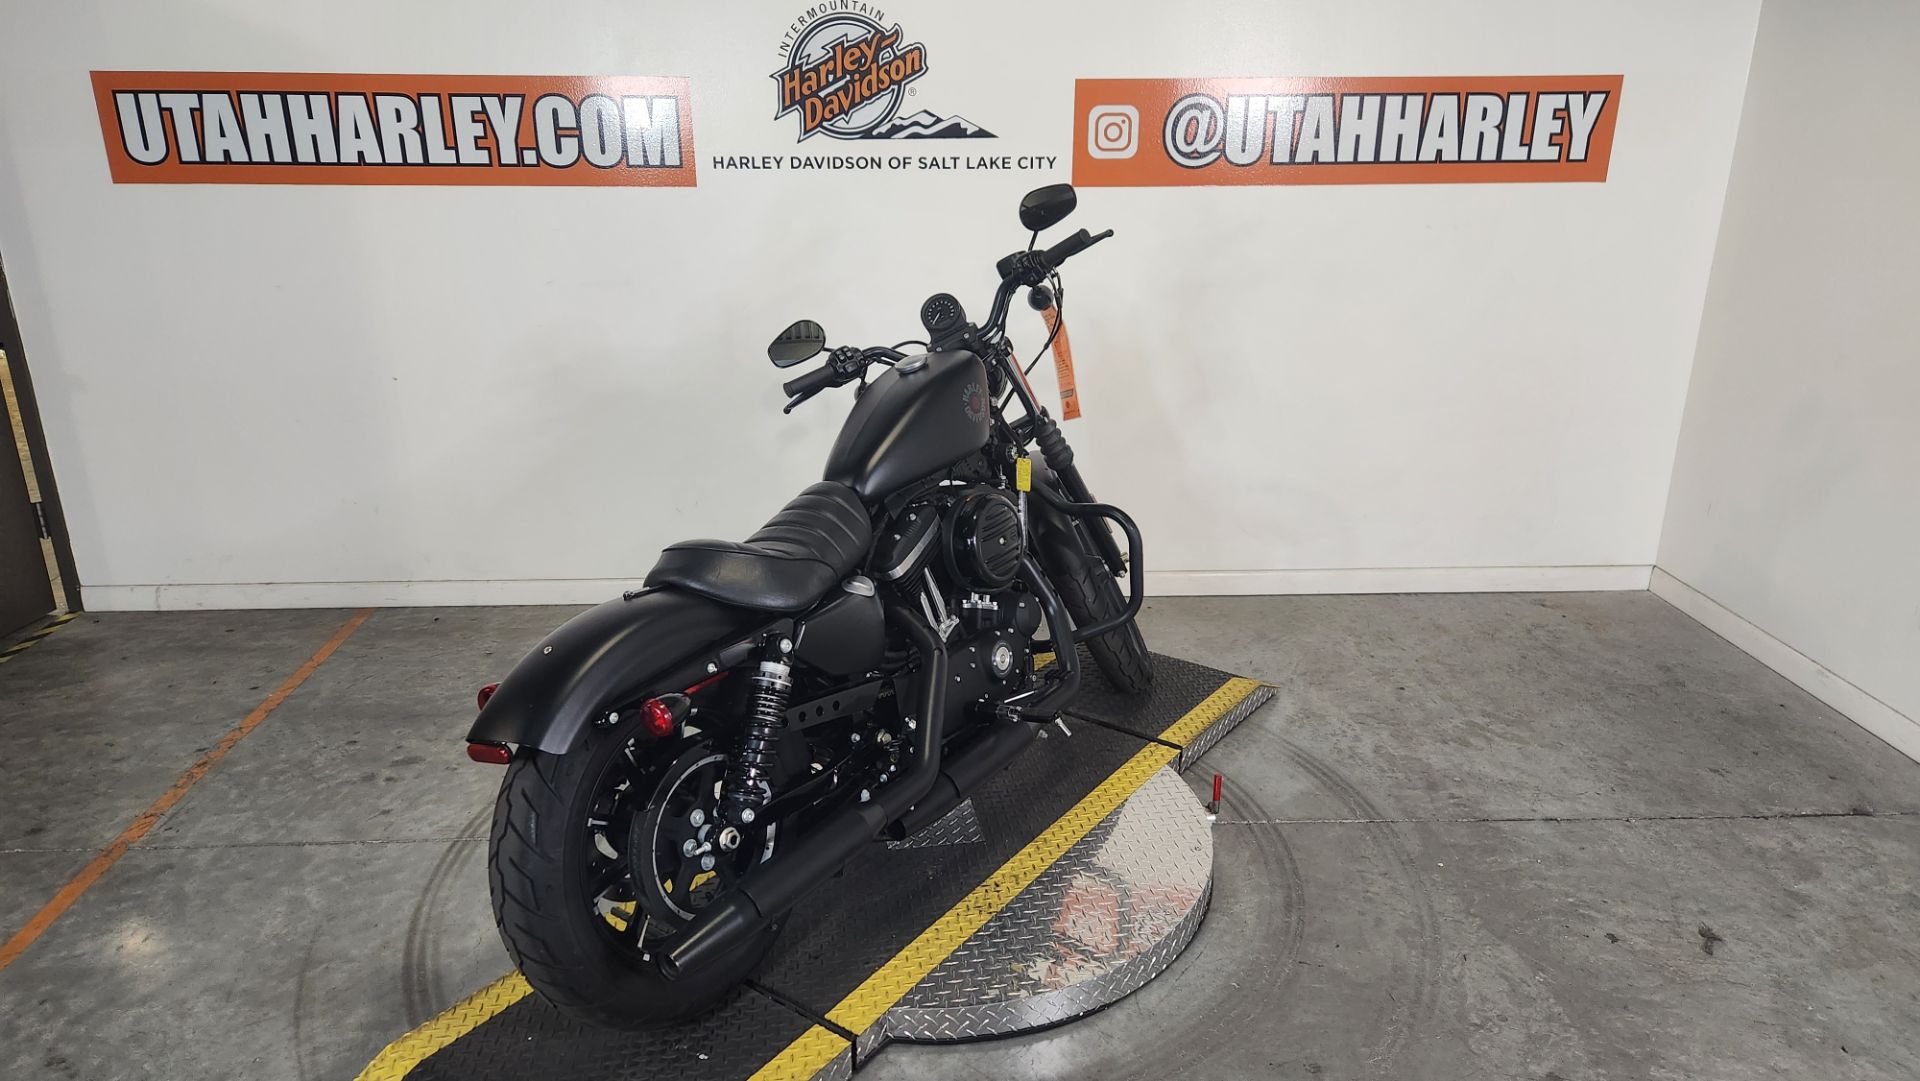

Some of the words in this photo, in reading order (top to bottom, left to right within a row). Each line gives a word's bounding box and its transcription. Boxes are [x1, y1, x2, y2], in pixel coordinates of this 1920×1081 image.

[777, 0, 885, 58] INTERMOUNTAIN
[804, 46, 922, 132] Davidson
[111, 89, 683, 169] UTAHHARLEY.COM
[712, 156, 784, 170] HARLEY
[790, 156, 882, 170] DAVIDSON
[888, 156, 912, 170] OF
[918, 156, 960, 170] SALT
[966, 156, 1012, 170] LAKE
[1017, 156, 1058, 170] CITY
[1163, 91, 1611, 169] @UTAHHARLEY
